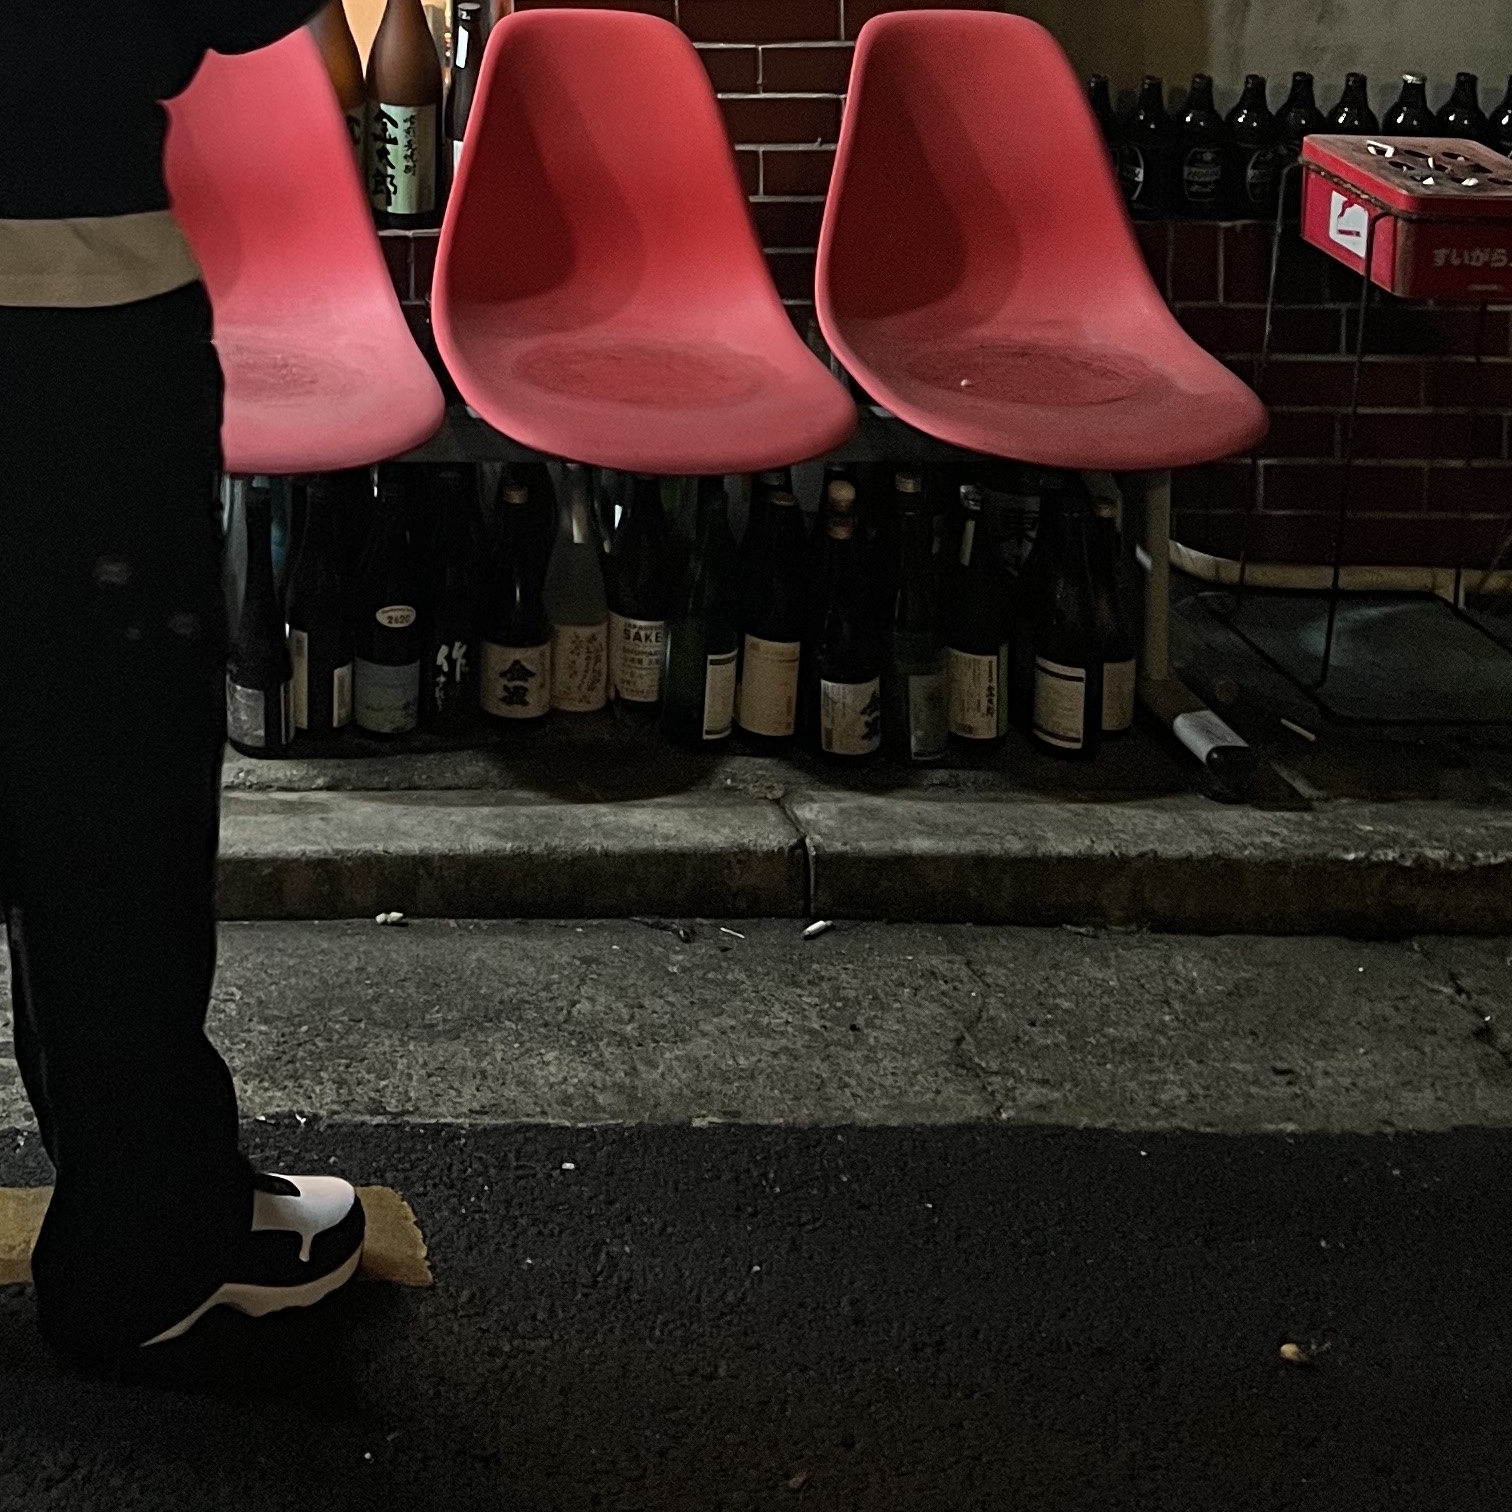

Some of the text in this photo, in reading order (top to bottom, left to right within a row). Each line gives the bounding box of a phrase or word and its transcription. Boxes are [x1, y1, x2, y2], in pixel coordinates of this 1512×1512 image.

[1432, 247, 1512, 268] すいがら
[622, 628, 662, 643] SAKE
